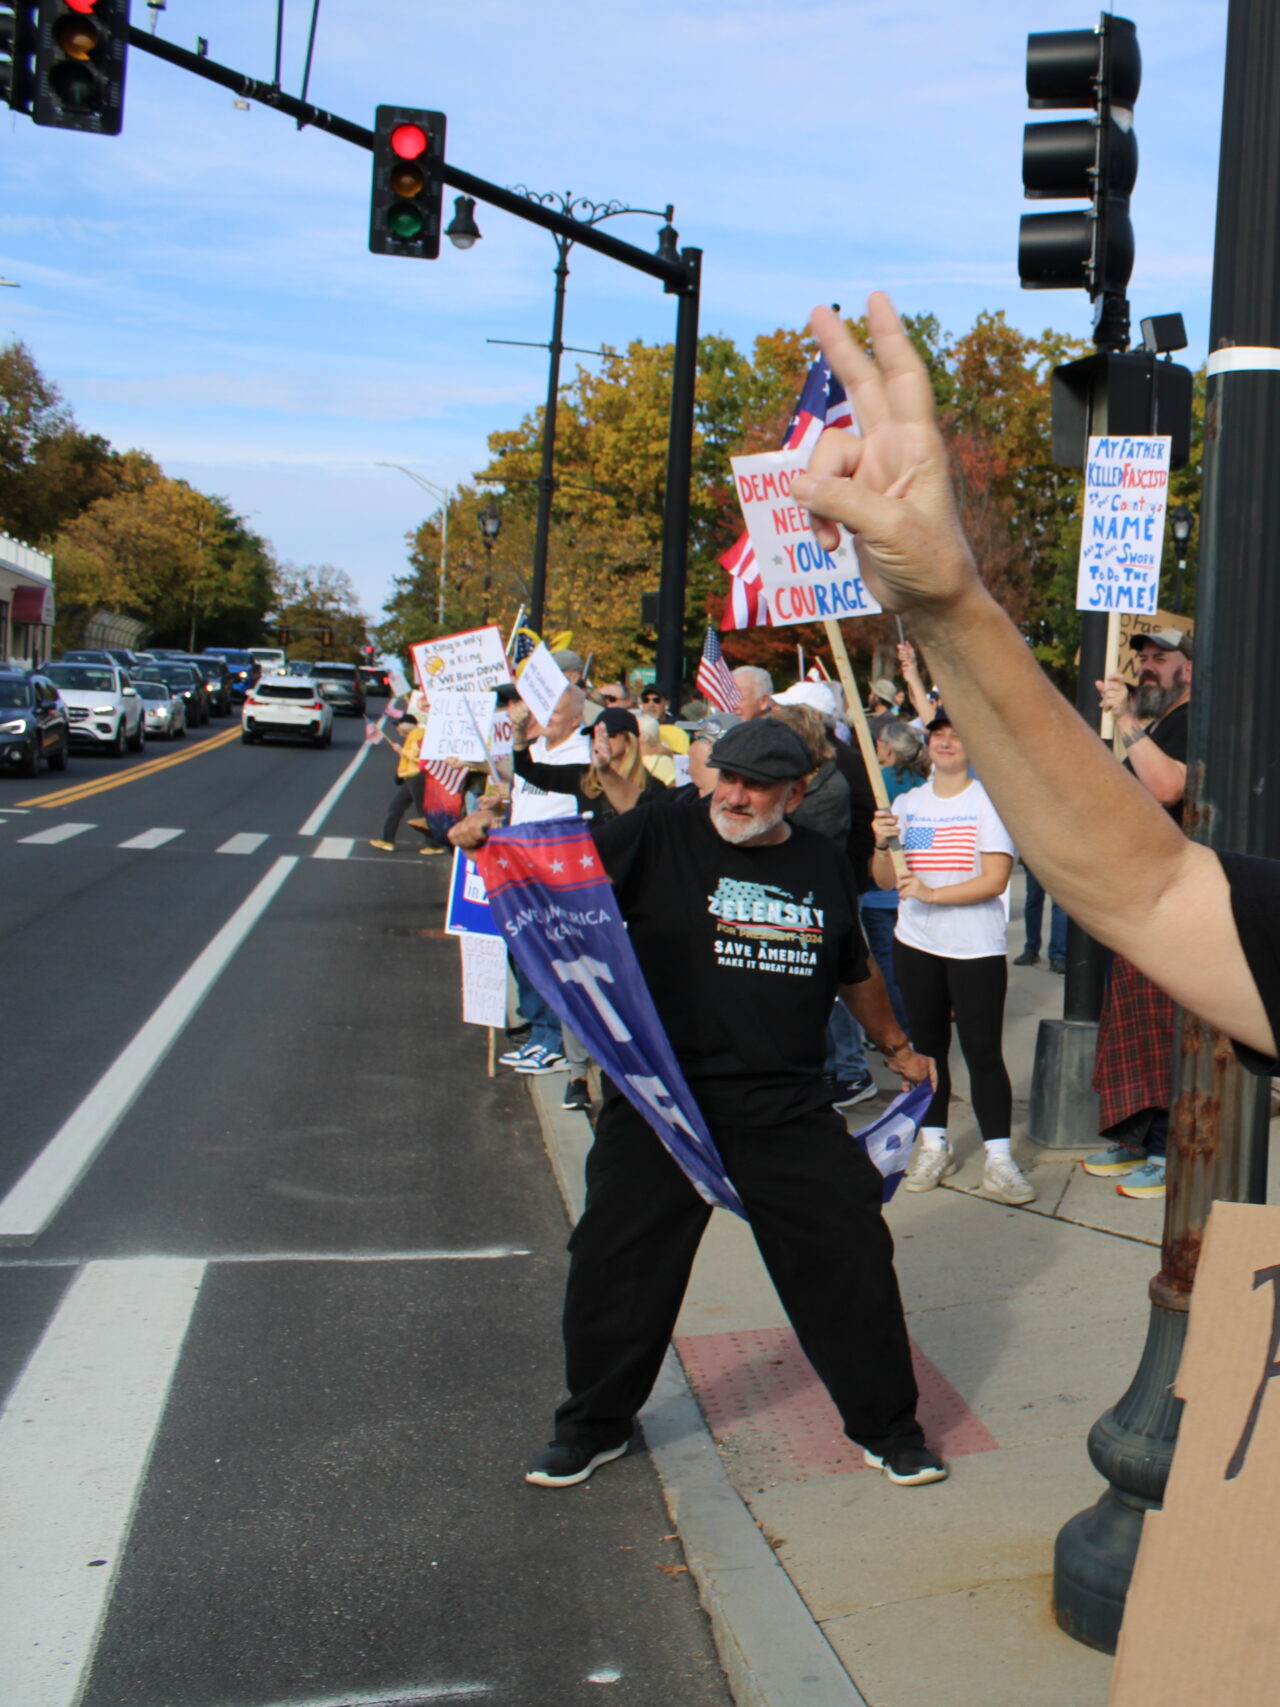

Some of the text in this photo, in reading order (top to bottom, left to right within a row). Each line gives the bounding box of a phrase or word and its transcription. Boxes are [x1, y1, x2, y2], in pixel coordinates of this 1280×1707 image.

[1095, 437, 1164, 459] MY FATHER
[1088, 462, 1122, 487] KILLED
[1093, 516, 1154, 540] NAME
[784, 542, 836, 574] YOUR
[1094, 543, 1104, 560] I
[1123, 568, 1148, 582] THE
[776, 578, 868, 620] COURAGE
[1089, 582, 1156, 612] SAME!
[432, 698, 490, 716] SILECE
[442, 720, 454, 736] IS
[494, 722, 512, 742] NO
[438, 739, 476, 754] ENEMY
[707, 895, 824, 928] ZELENSKY
[716, 923, 736, 936] FOR
[739, 929, 796, 942] PRESIDENT
[714, 940, 818, 966] SAVE AMERICA
[718, 956, 814, 976] MAKE IT GREAT AGAIN
